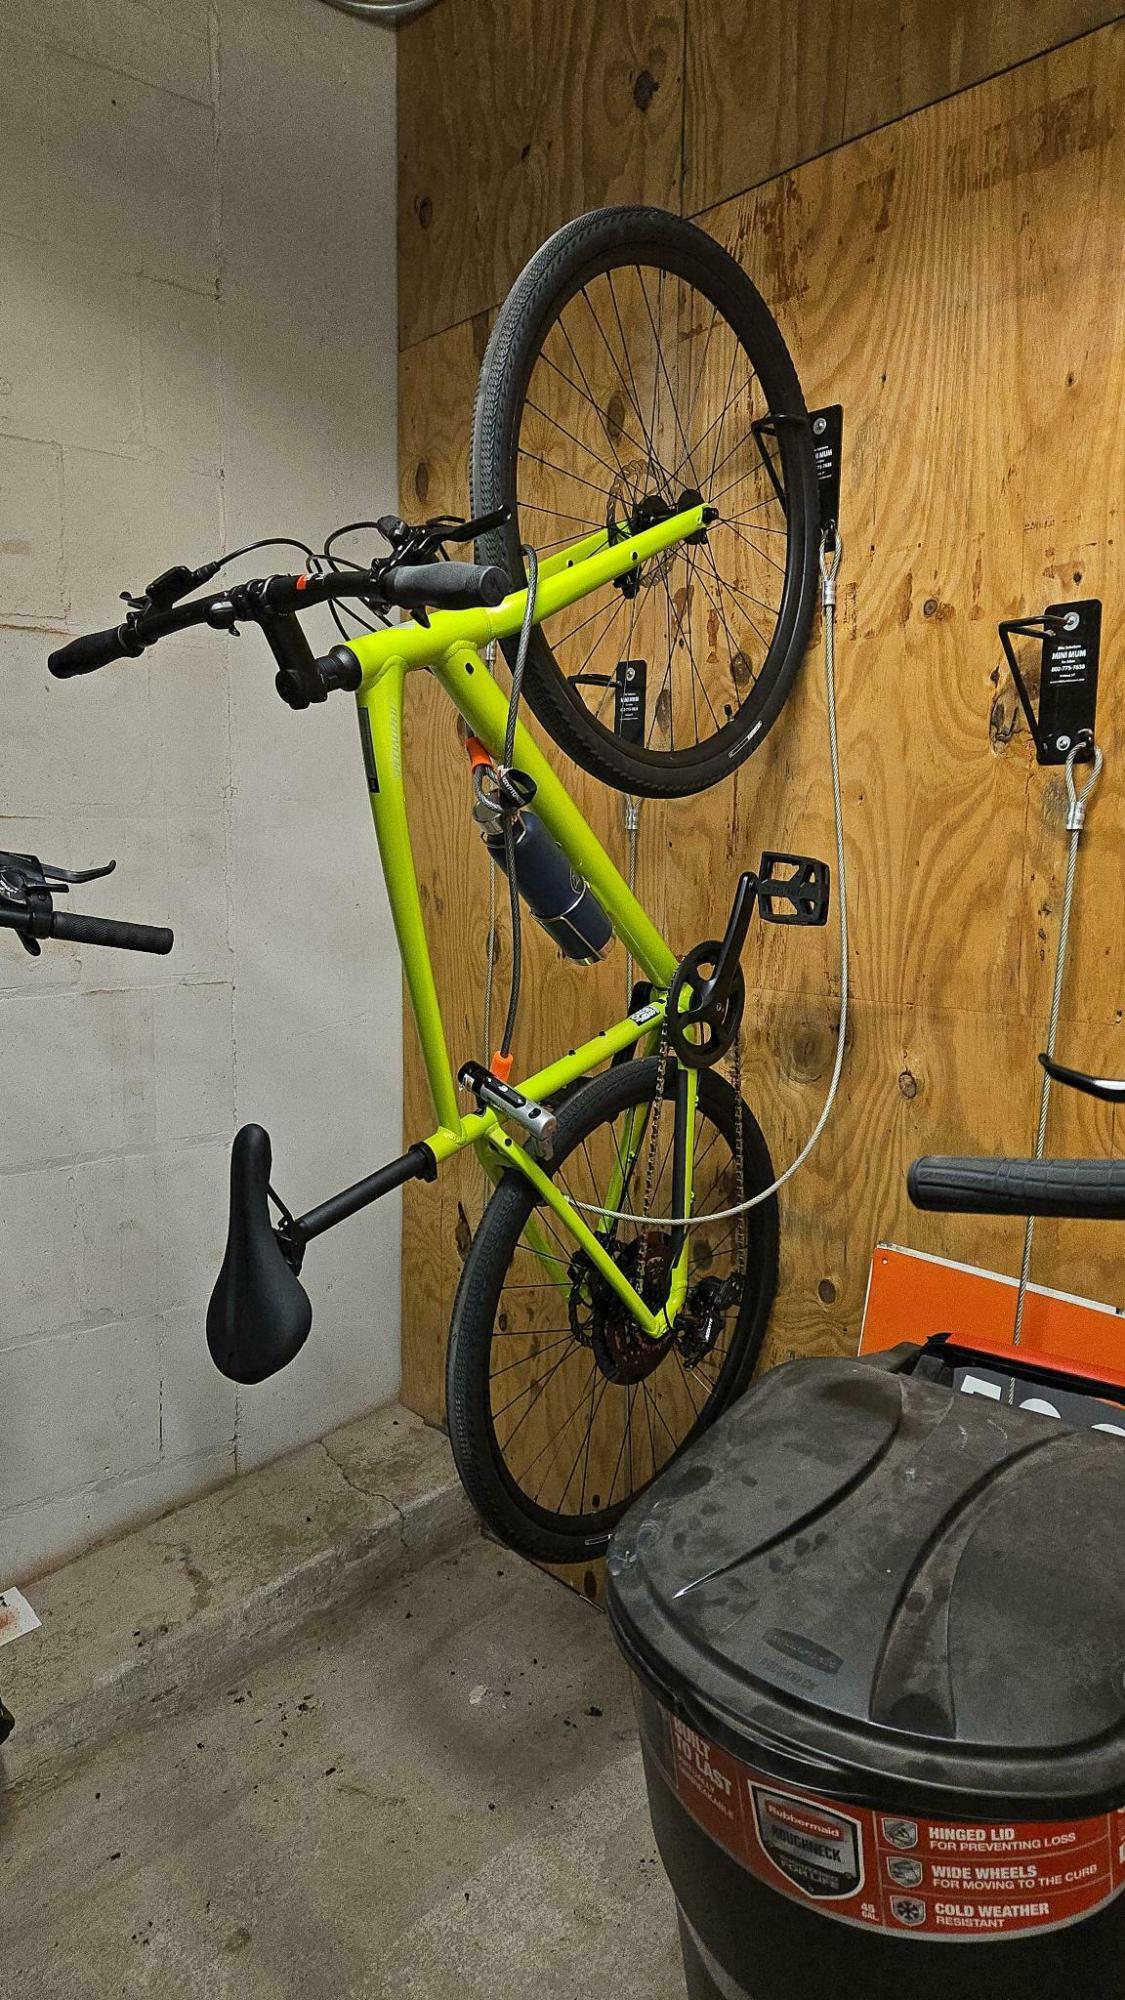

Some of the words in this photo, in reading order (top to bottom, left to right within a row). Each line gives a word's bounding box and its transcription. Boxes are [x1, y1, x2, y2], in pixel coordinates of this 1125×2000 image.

[695, 1753, 732, 1796] LAST
[768, 1804, 840, 1838] Rubbermaid
[928, 1826, 986, 1841] HINGED
[991, 1828, 1016, 1841] LID
[930, 1840, 957, 1852] FOR
[960, 1839, 1041, 1852] PREVENTING
[1044, 1832, 1077, 1847] LOSS
[771, 1825, 842, 1863] ROUGHNECK
[931, 1864, 972, 1879] WIDE
[974, 1865, 1038, 1880] WHEELS
[933, 1878, 960, 1890] FOR
[963, 1878, 1015, 1890] MOVING
[1019, 1878, 1036, 1889] TO
[1038, 1874, 1063, 1888] THE
[1065, 1863, 1098, 1882] CURB
[934, 1902, 975, 1917] COLD
[978, 1902, 1050, 1918] WEATHER
[935, 1915, 1007, 1929] RESISTANT
